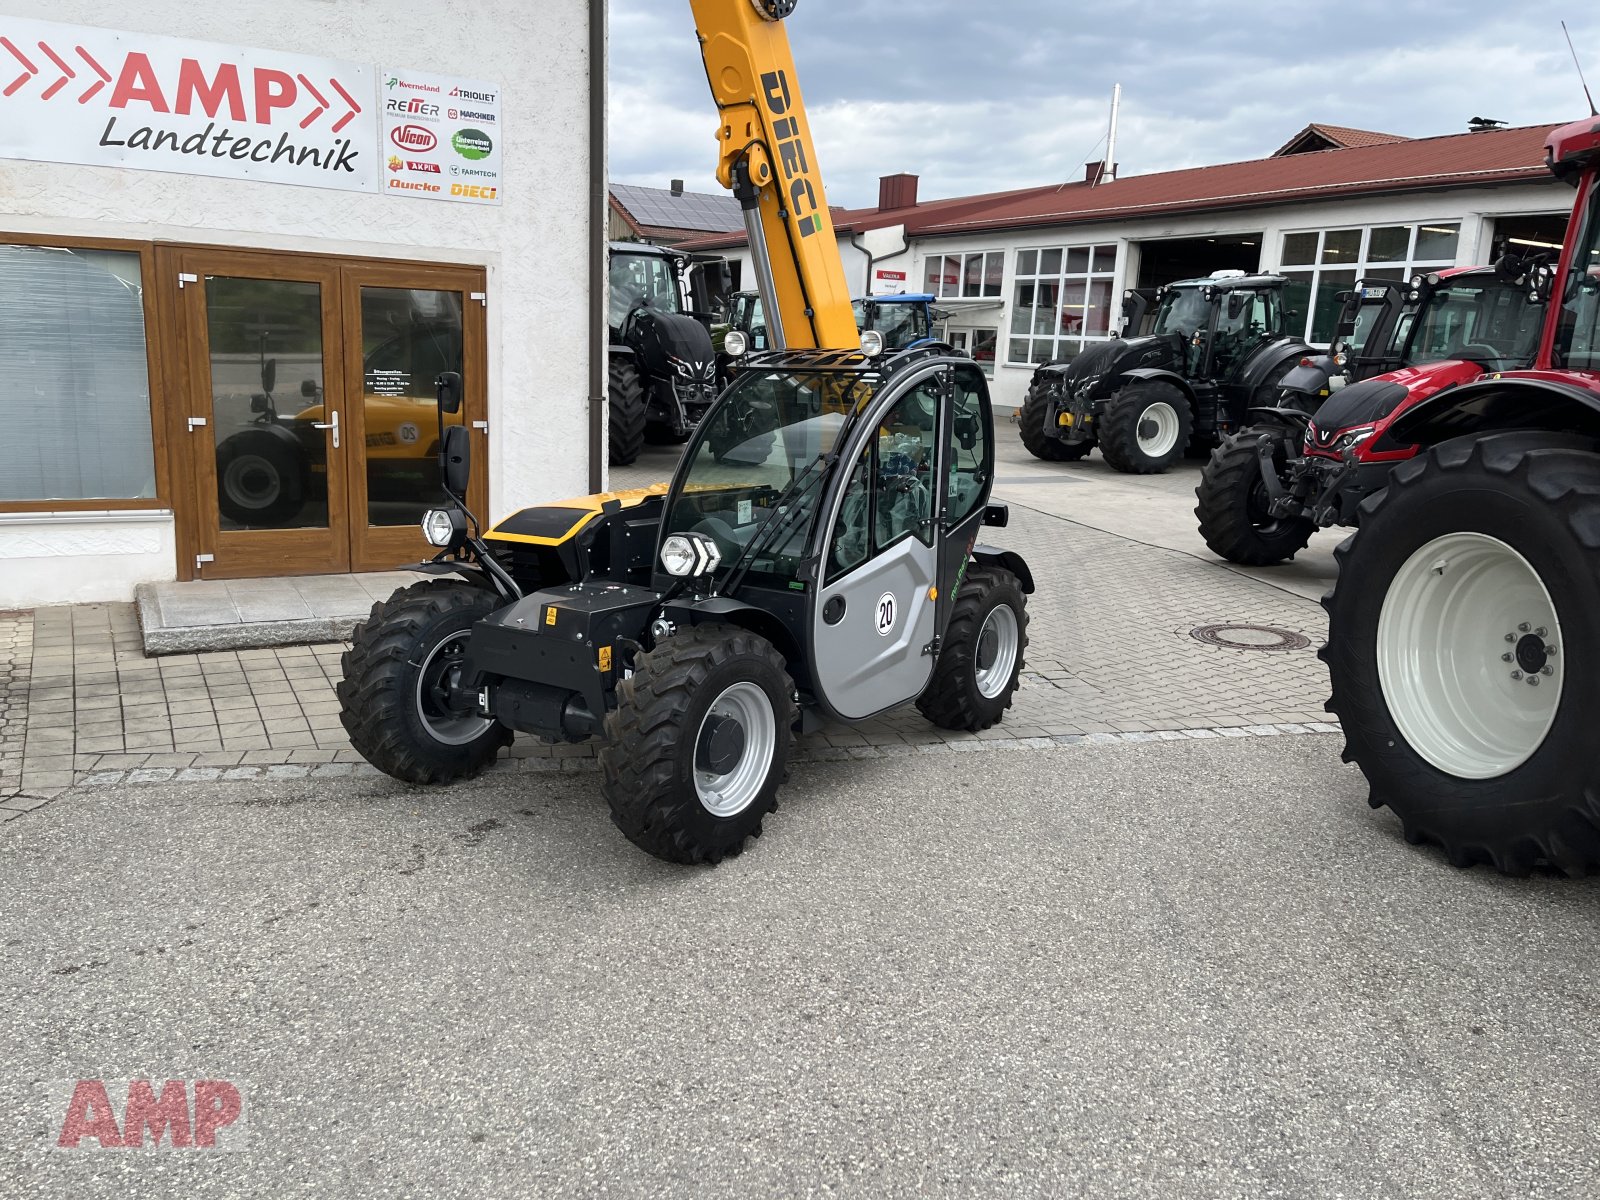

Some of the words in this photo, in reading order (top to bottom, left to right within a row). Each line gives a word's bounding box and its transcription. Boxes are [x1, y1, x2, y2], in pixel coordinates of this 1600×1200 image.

[108, 51, 298, 126] AMP
[399, 80, 440, 93] Kverneland
[459, 89, 496, 102] TRIOLIET
[397, 125, 432, 147] Vicon
[99, 116, 362, 174] Landtechnik
[411, 162, 436, 172] AKPIL
[461, 168, 497, 178] FARMTECH
[390, 179, 441, 193] Quicke
[879, 599, 893, 629] 20
